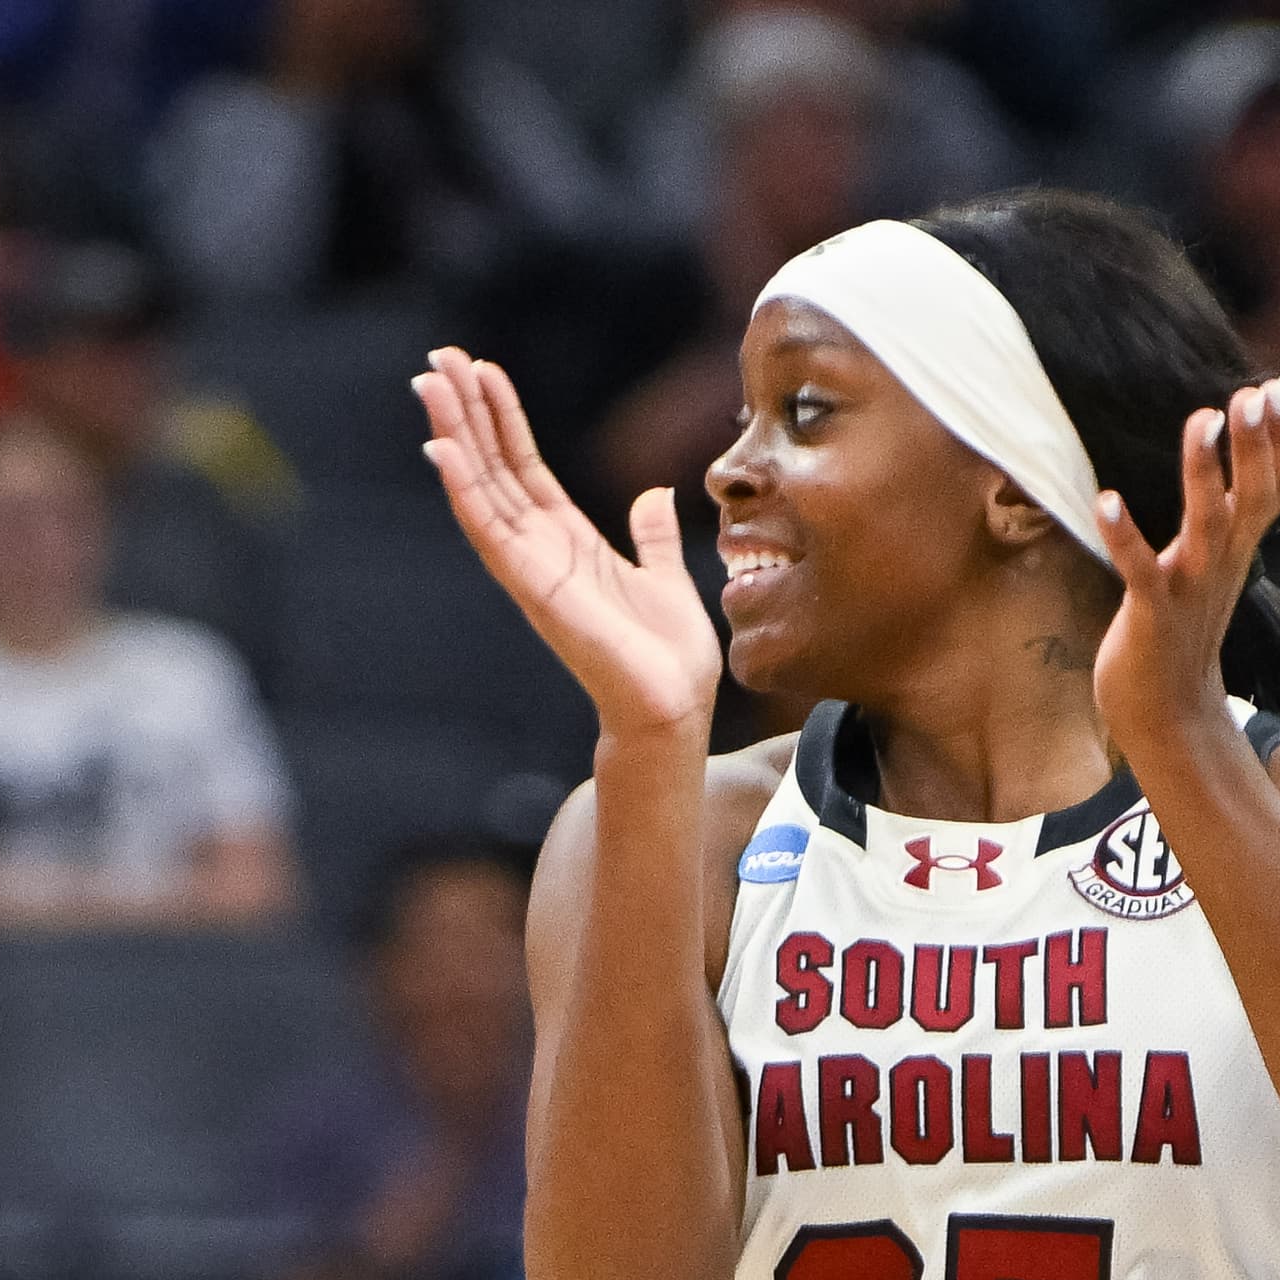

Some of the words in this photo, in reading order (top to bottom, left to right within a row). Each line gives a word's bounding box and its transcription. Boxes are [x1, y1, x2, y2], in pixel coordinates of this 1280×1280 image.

[1085, 882, 1185, 914] GRADUAT
[775, 926, 1110, 1036] SOUTH
[755, 1049, 1204, 1178] AROLINA
